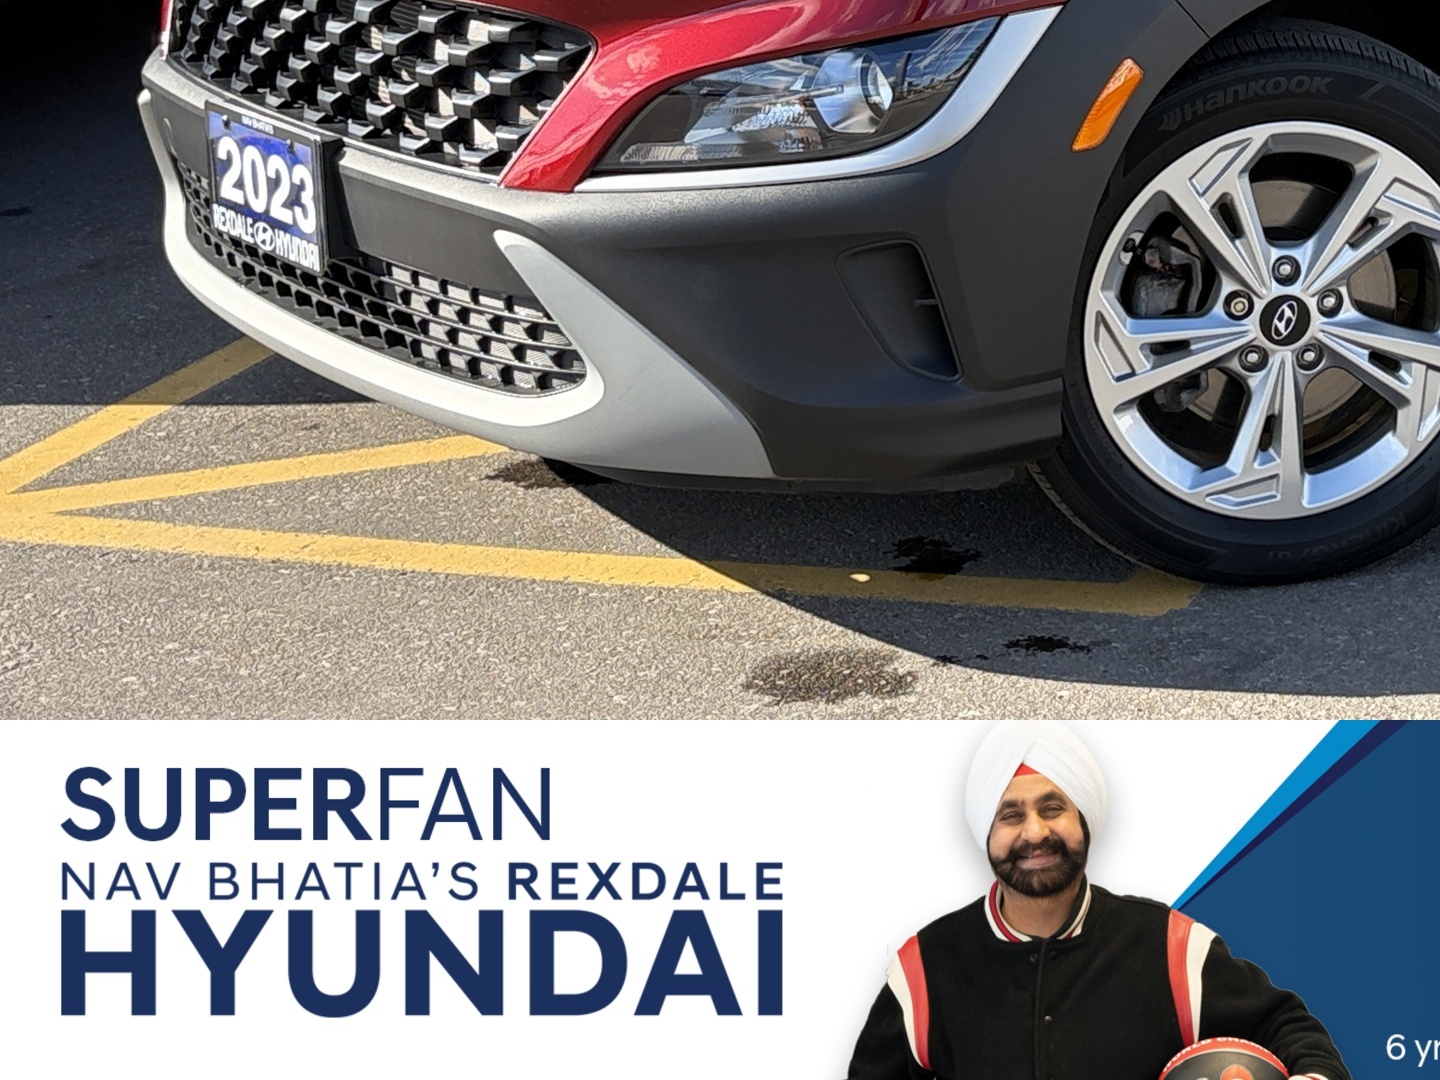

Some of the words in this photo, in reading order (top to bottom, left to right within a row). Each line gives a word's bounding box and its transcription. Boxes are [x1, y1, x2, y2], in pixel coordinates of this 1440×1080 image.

[217, 136, 317, 235] 2023
[212, 203, 255, 244] REXDALE
[274, 228, 321, 273] HYUNDAI
